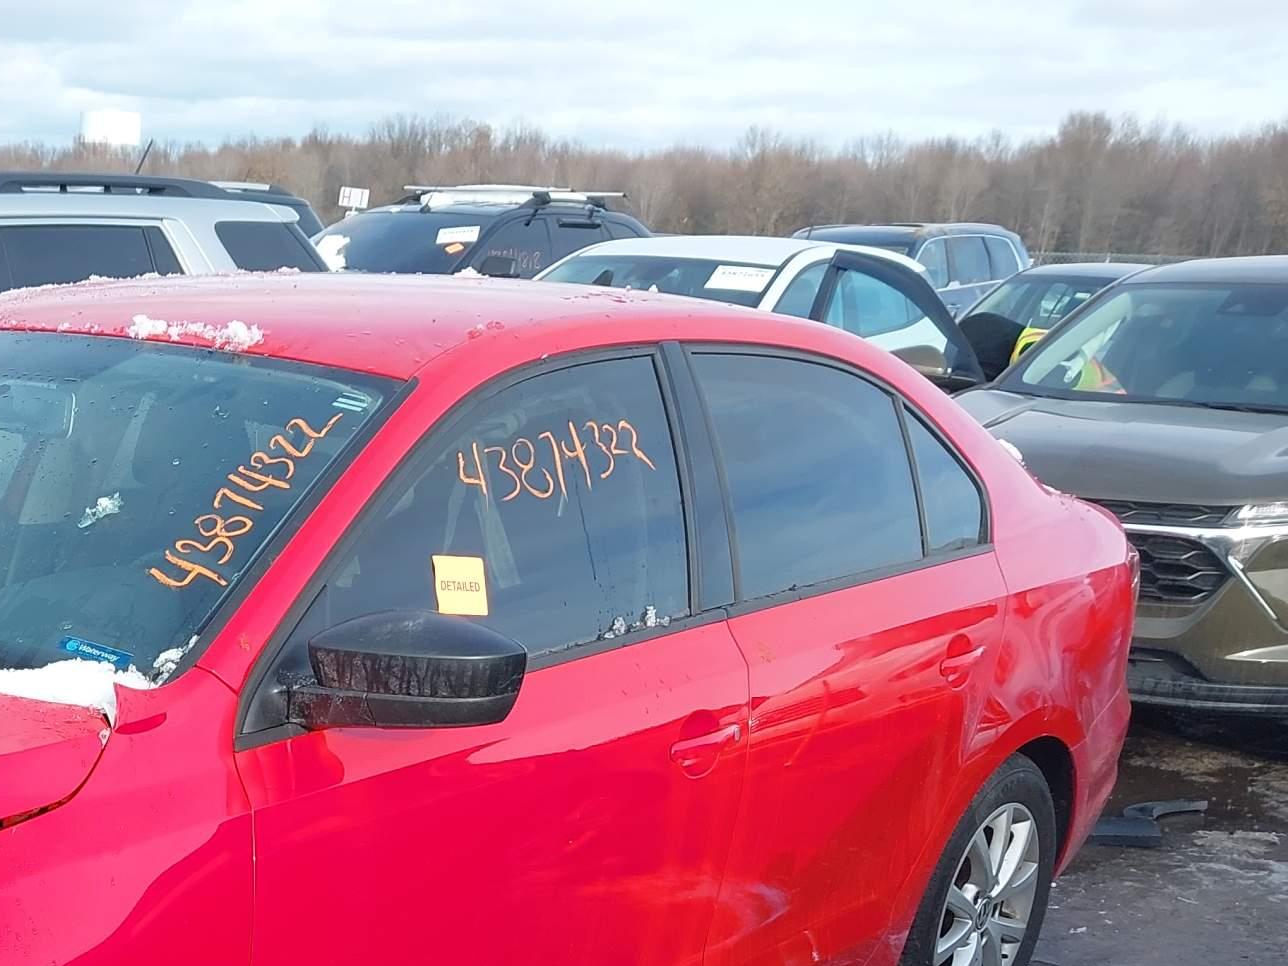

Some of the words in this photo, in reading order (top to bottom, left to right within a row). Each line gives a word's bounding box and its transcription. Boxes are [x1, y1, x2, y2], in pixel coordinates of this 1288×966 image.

[457, 418, 657, 511] 43874322
[148, 412, 344, 587] 43874322
[440, 580, 481, 593] DETAILED
[78, 643, 121, 662] Waterway
